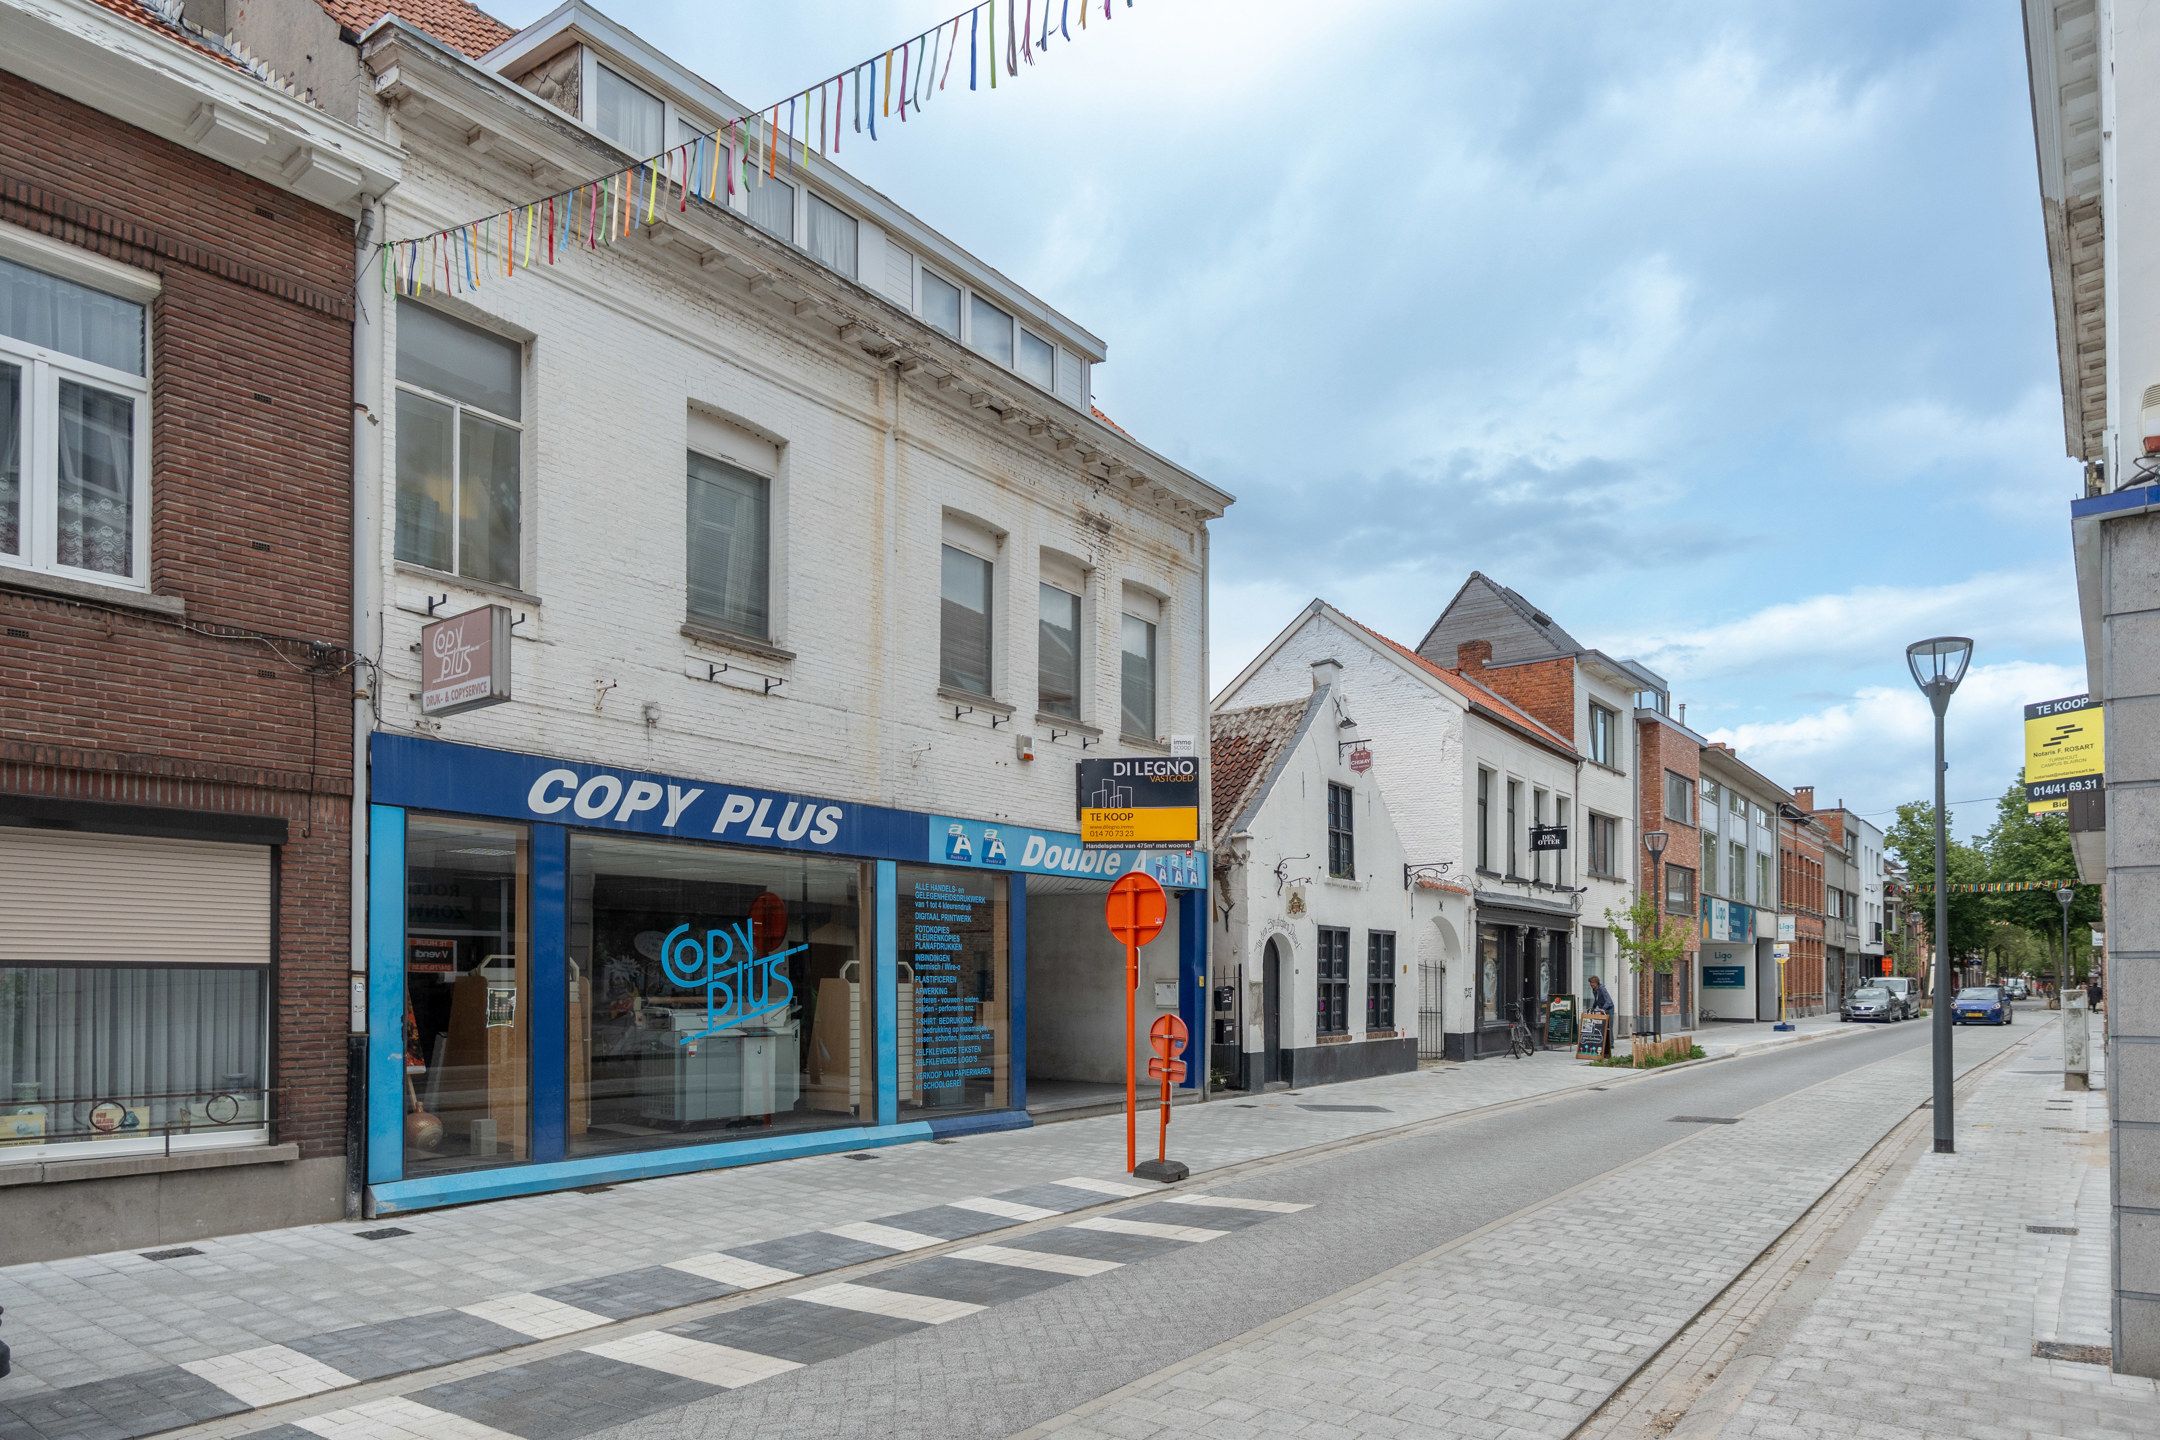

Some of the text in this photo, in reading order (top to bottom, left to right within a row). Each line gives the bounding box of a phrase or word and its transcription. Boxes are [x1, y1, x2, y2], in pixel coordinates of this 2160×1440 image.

[451, 681, 488, 702] COPYSERVICE
[2036, 698, 2090, 716] TE KOOP
[2033, 749, 2055, 758] Notaris
[2064, 743, 2095, 753] ROSART
[1113, 760, 1194, 776] DI LEGNO
[2033, 779, 2097, 797] 014/41.69.31
[527, 768, 843, 844] COPY PLUS
[1090, 813, 1134, 821] TE KOOP
[1020, 835, 1121, 875] Double
[931, 884, 957, 893] HANDELS-
[915, 891, 986, 904] GELEGENHEIDSDRUKWERK
[942, 902, 972, 911] kleurendruk
[915, 912, 972, 922] DIGITAAL PRINTWERK
[915, 925, 950, 933] FOTOKOPIES
[915, 934, 960, 942] KLEURENKOPIES
[915, 943, 963, 951] PLANAFDRUKKEN
[915, 954, 950, 962] INBINDINGEN
[1714, 952, 1732, 961] Ligo
[915, 975, 957, 984] PLASTIFICEREN
[915, 987, 948, 995] AFWERKING
[923, 1026, 952, 1035] bedrukking
[915, 1045, 982, 1056] ZELFKLEVENDE TEKSTEN
[915, 1056, 978, 1067] ZELFKLEVENDE LOGO'S
[916, 1068, 992, 1080] VERKOOP VAN PAPIERWAREN
